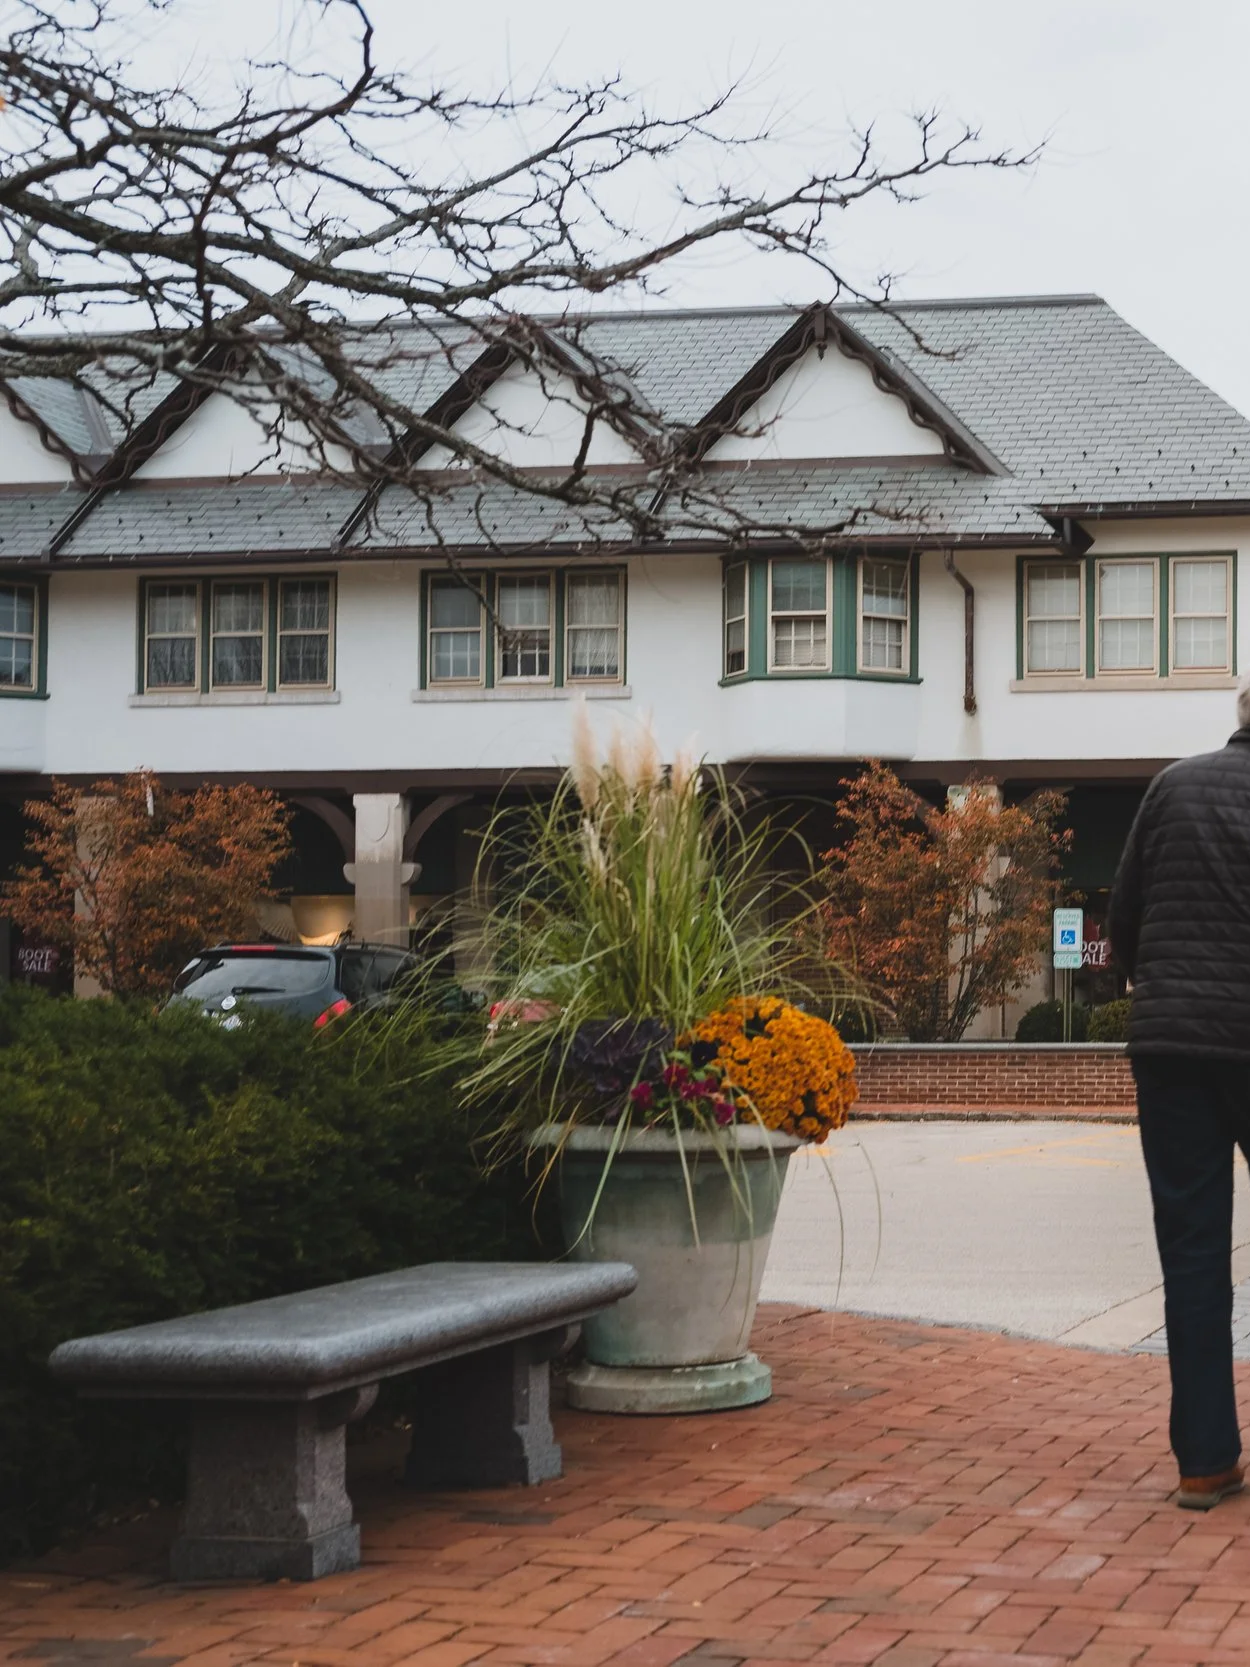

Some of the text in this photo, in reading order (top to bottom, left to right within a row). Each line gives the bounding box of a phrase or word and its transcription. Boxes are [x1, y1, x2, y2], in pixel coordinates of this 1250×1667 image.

[18, 947, 52, 961] BOOT
[1082, 952, 1107, 966] ALE
[22, 959, 51, 973] SALE
